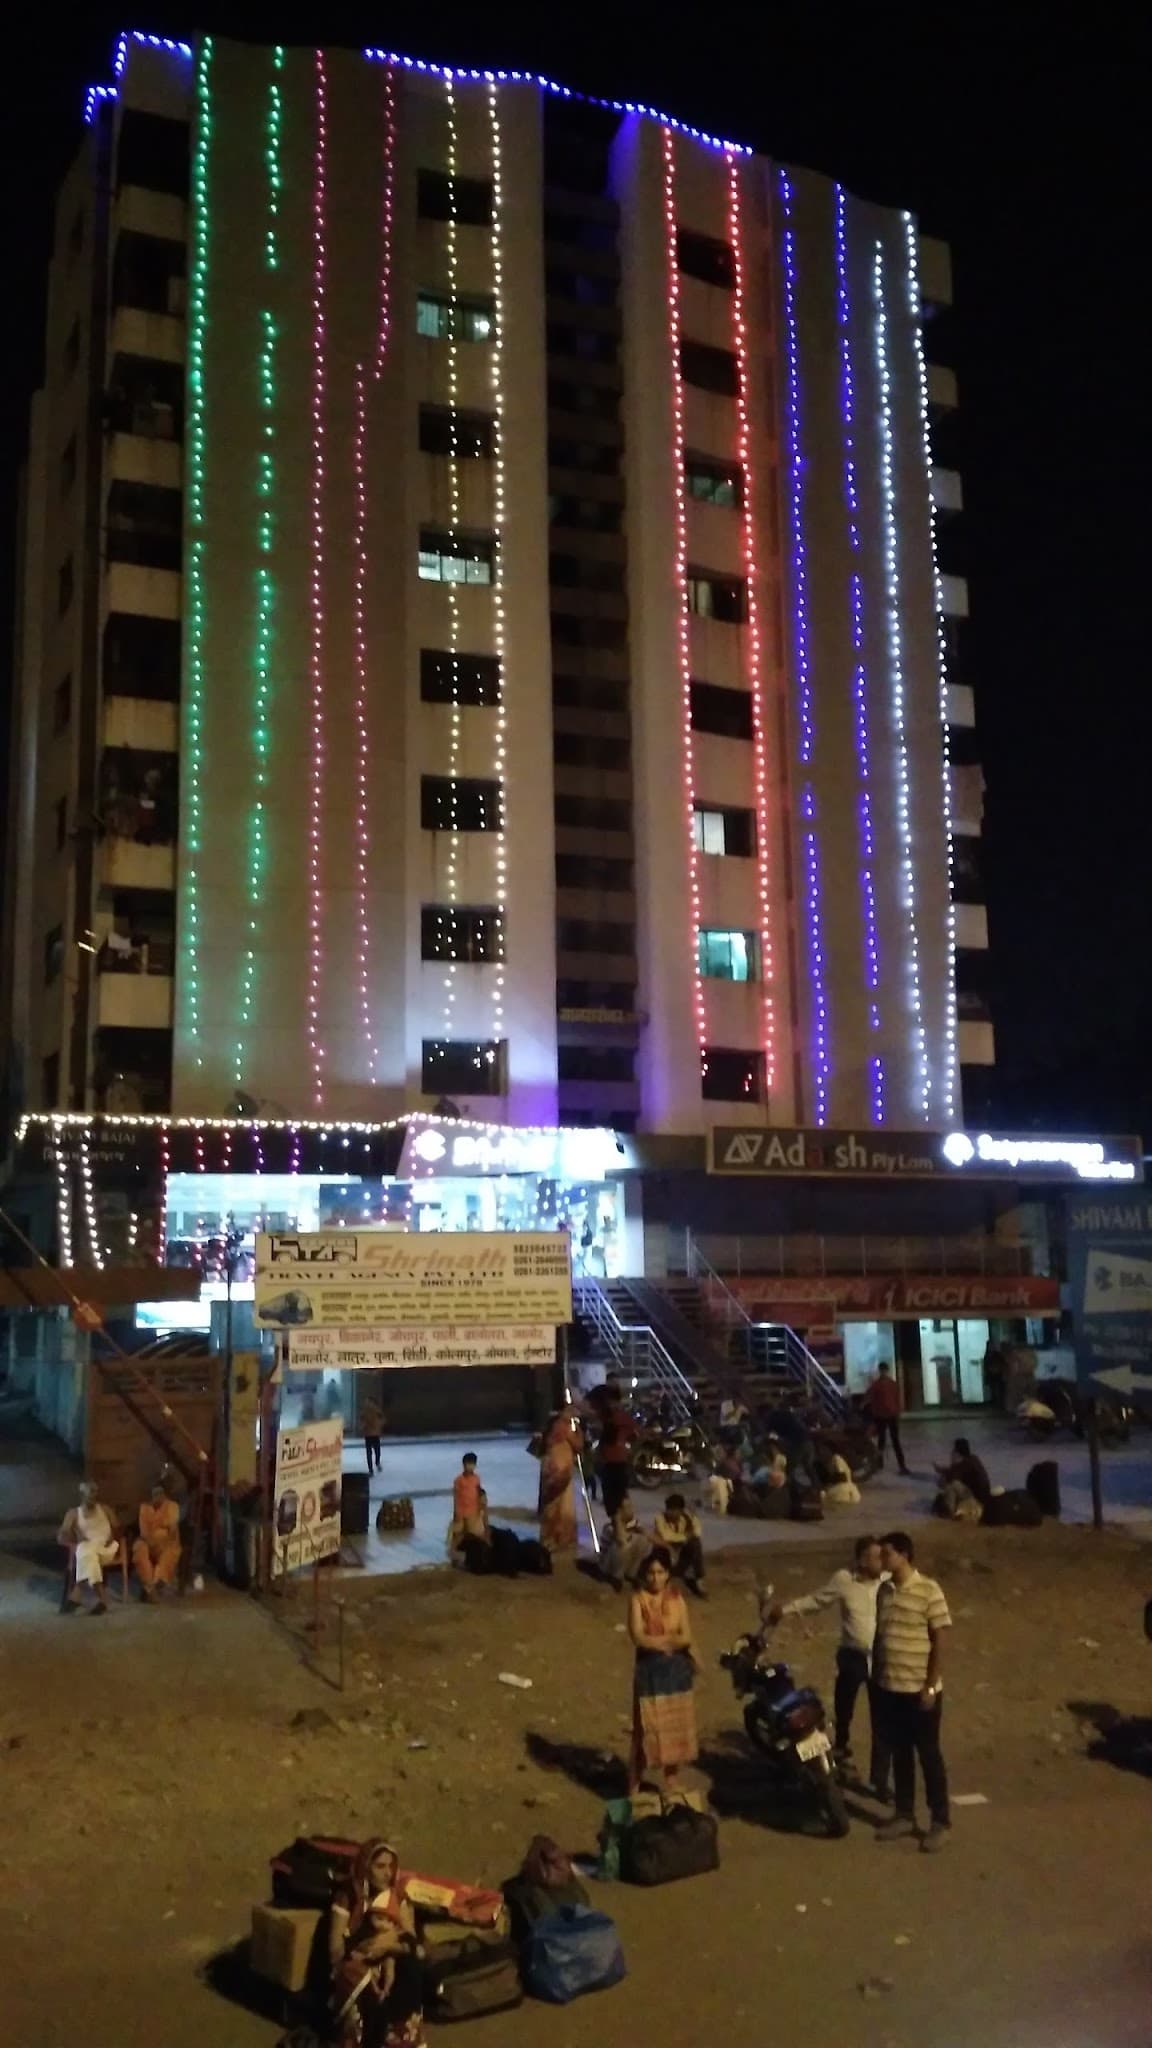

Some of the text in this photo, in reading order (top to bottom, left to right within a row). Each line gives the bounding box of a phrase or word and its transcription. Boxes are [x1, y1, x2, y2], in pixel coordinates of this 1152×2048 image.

[1071, 1205, 1142, 1231] SHIVAM
[364, 1245, 507, 1269] Shrinath
[969, 1285, 1031, 1306] Bank
